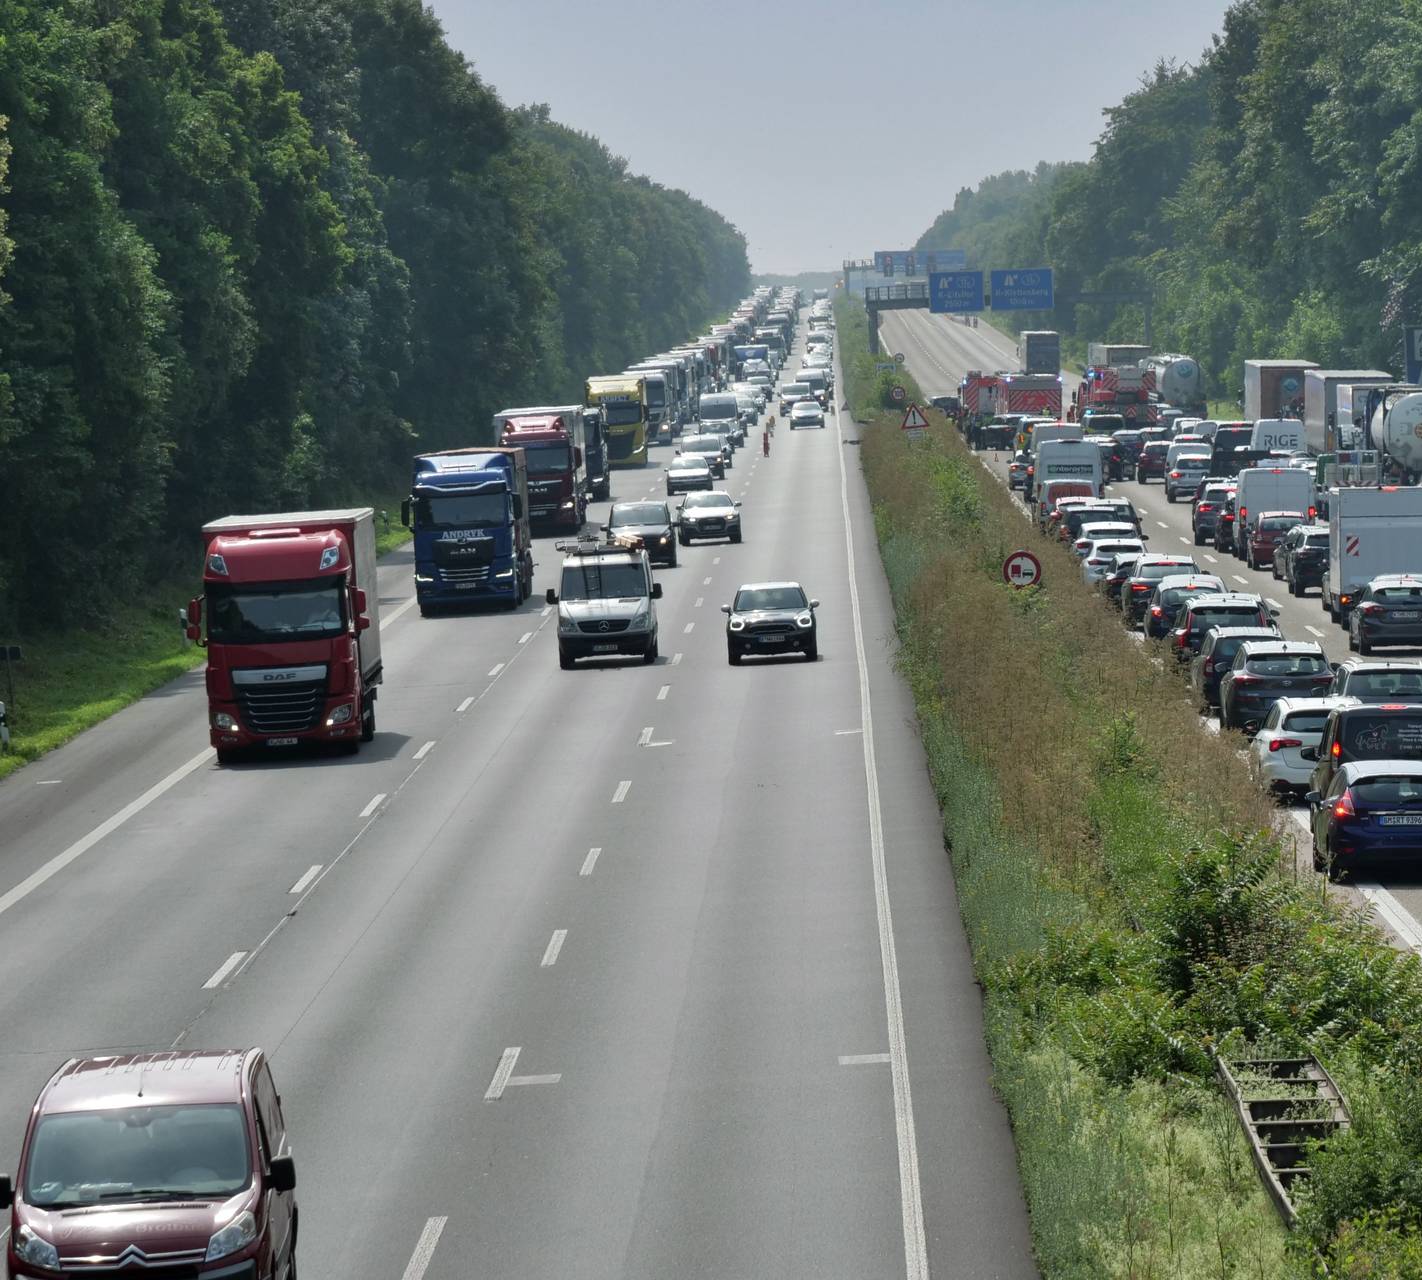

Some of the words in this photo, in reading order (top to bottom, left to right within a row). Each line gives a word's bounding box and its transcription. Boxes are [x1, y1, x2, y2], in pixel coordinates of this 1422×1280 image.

[1264, 434, 1298, 447] RIGE
[441, 529, 485, 540] ANDRYK
[264, 673, 297, 681] DAF
